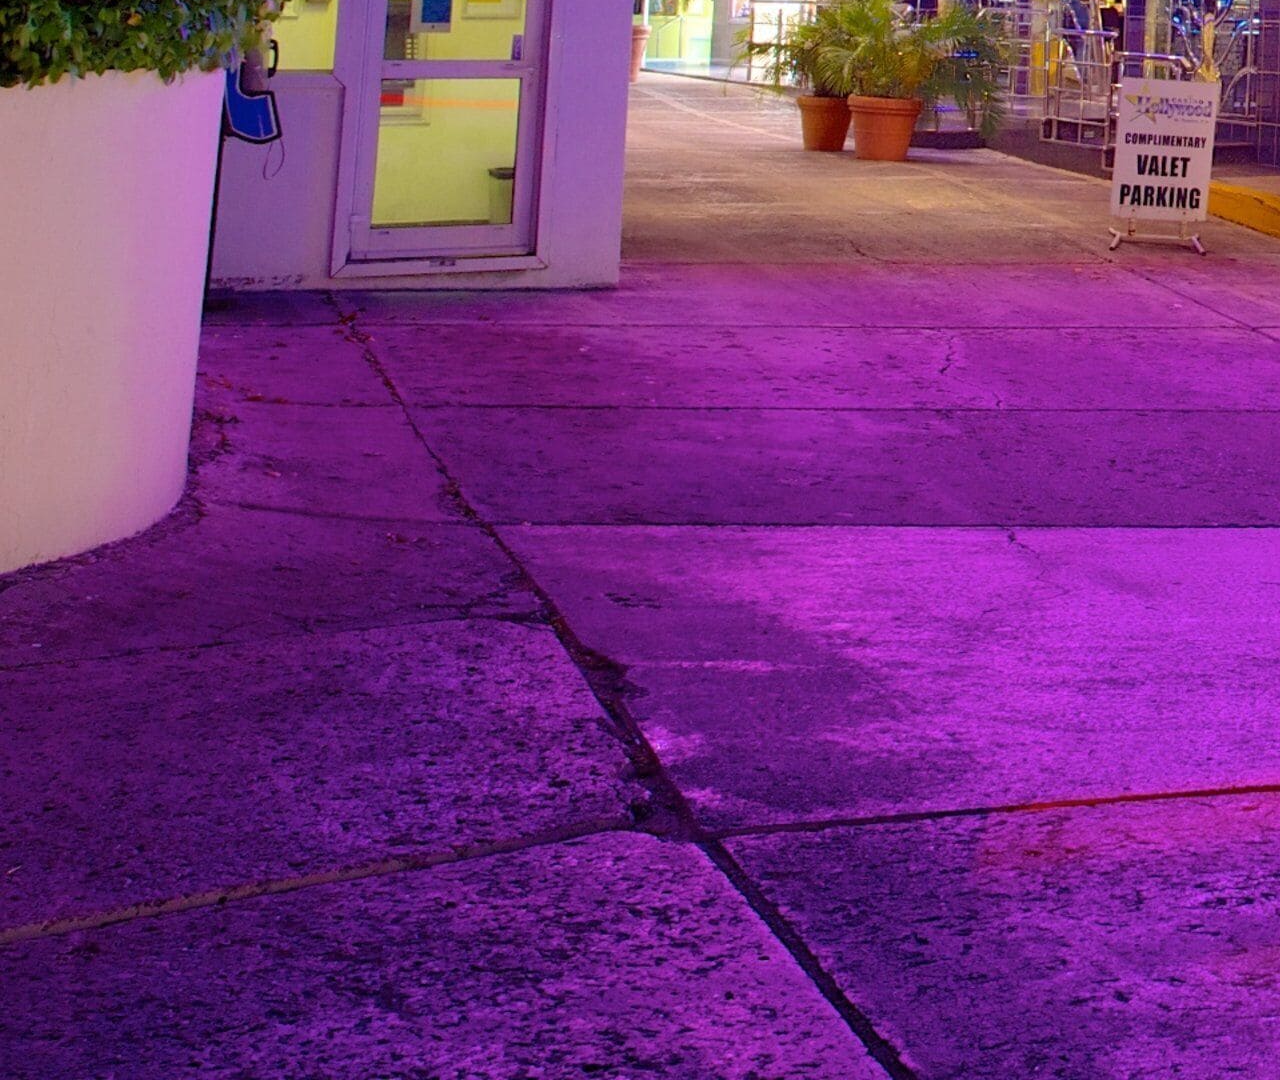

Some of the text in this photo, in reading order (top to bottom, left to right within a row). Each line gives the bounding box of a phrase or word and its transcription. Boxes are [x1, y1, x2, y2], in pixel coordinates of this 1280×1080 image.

[1125, 132, 1207, 149] COMPLIMENTARY
[1136, 153, 1191, 178] VALET
[1119, 183, 1202, 210] PARKING
